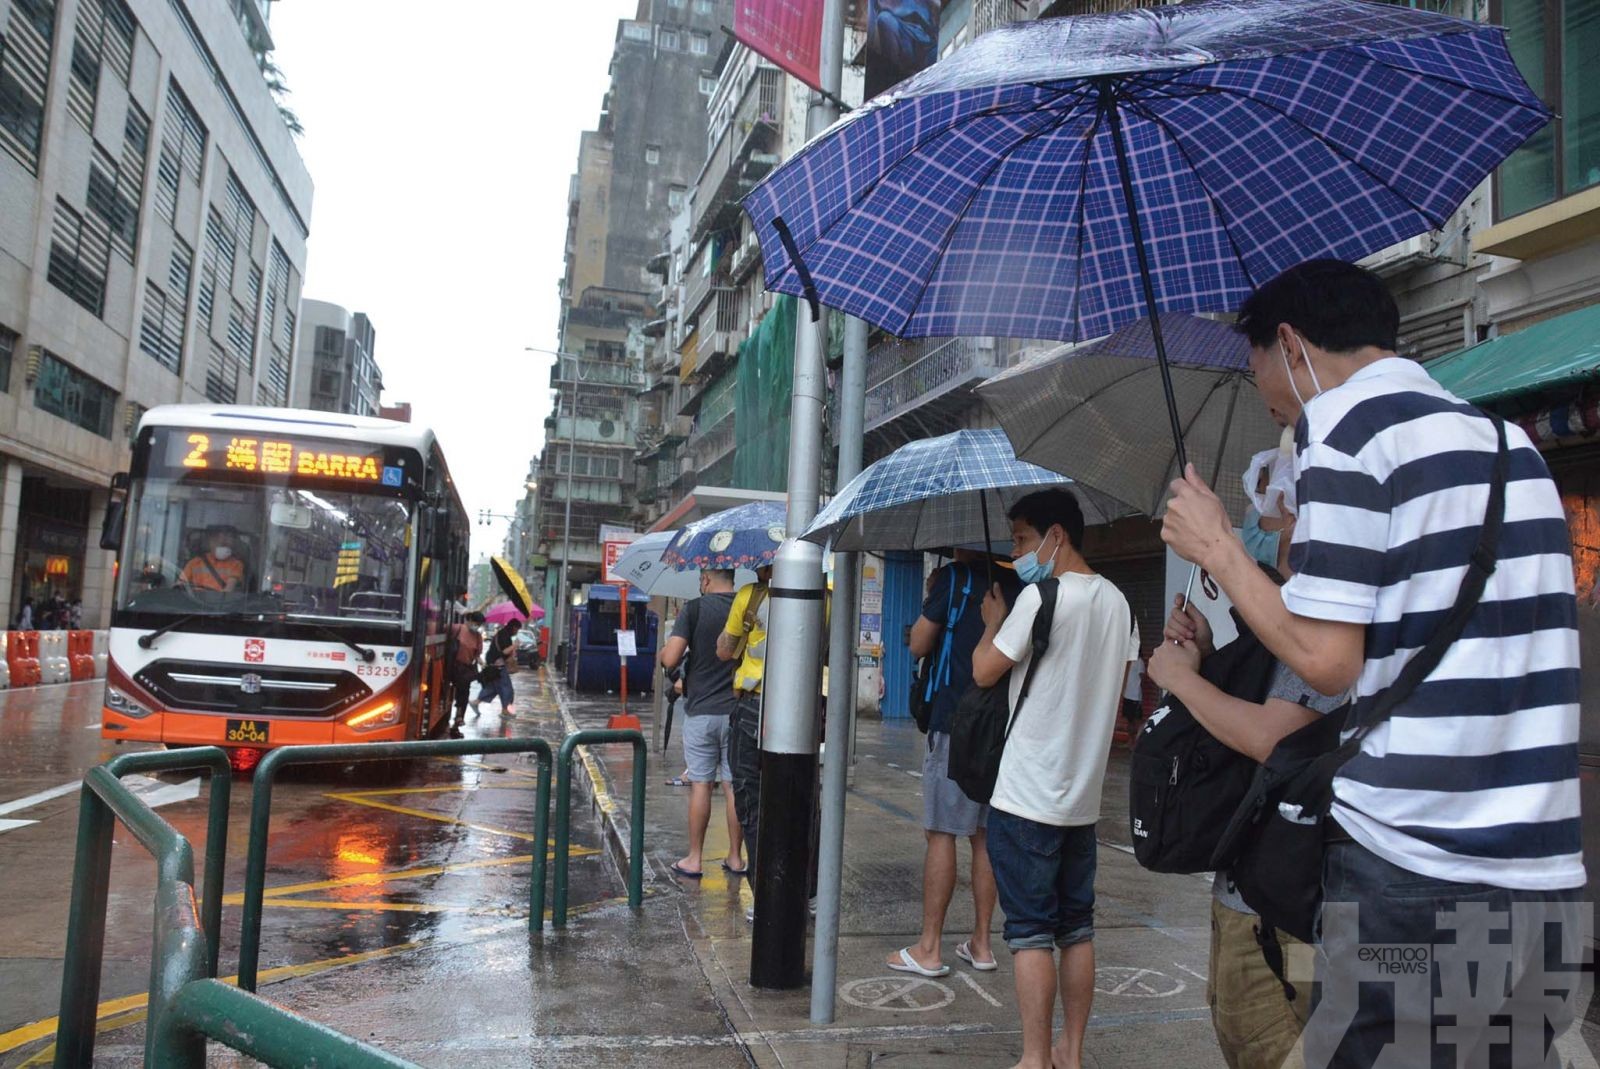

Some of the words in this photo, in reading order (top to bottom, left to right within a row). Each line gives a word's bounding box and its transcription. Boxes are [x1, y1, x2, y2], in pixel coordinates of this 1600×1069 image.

[183, 434, 209, 468] 2
[297, 452, 378, 479] BARRA
[356, 665, 398, 677] E3253
[240, 721, 255, 731] AA
[228, 730, 266, 742] 30-04
